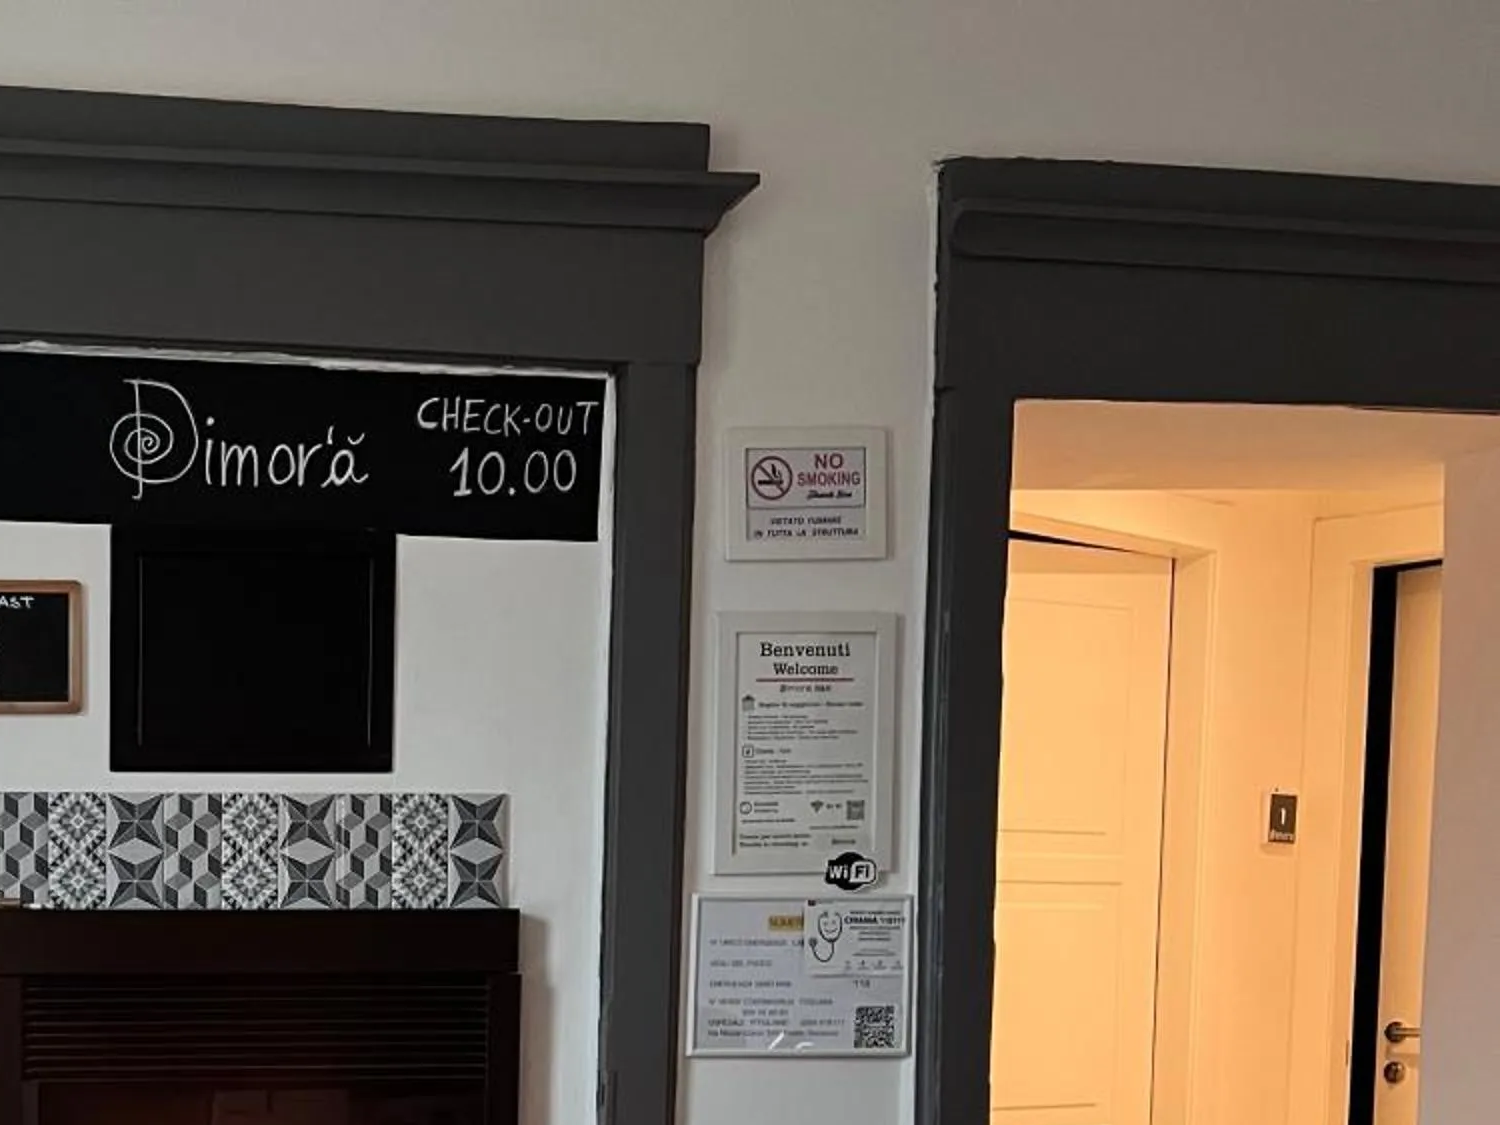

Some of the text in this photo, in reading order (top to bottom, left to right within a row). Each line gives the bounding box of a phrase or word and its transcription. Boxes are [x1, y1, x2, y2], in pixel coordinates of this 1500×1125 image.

[416, 395, 600, 437] CHECK-OUT
[814, 453, 844, 470] NO
[449, 447, 577, 497] 10.00
[796, 471, 861, 487] SMOKING
[759, 641, 851, 658] Benvenuti
[773, 662, 839, 676] Welcome
